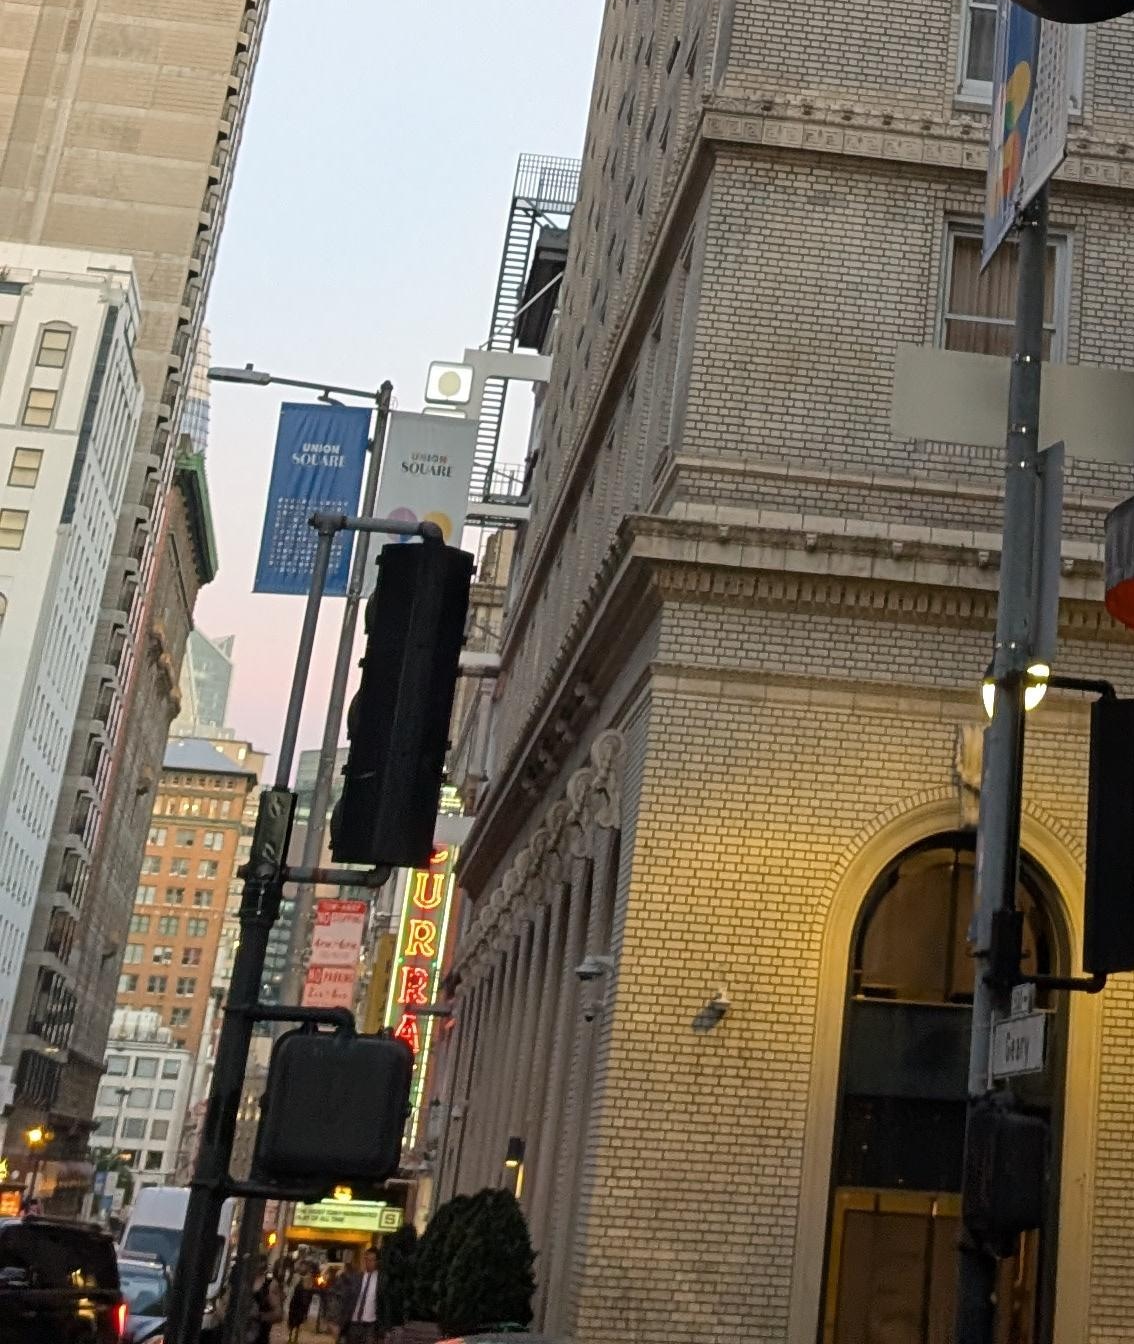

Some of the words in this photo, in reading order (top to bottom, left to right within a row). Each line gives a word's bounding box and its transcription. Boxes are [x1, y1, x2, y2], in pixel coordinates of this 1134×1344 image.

[302, 442, 342, 454] UNION
[292, 452, 345, 468] SQUARE
[410, 452, 448, 464] UNION
[401, 462, 454, 478] SQUARE
[1006, 1031, 1030, 1069] Geary
